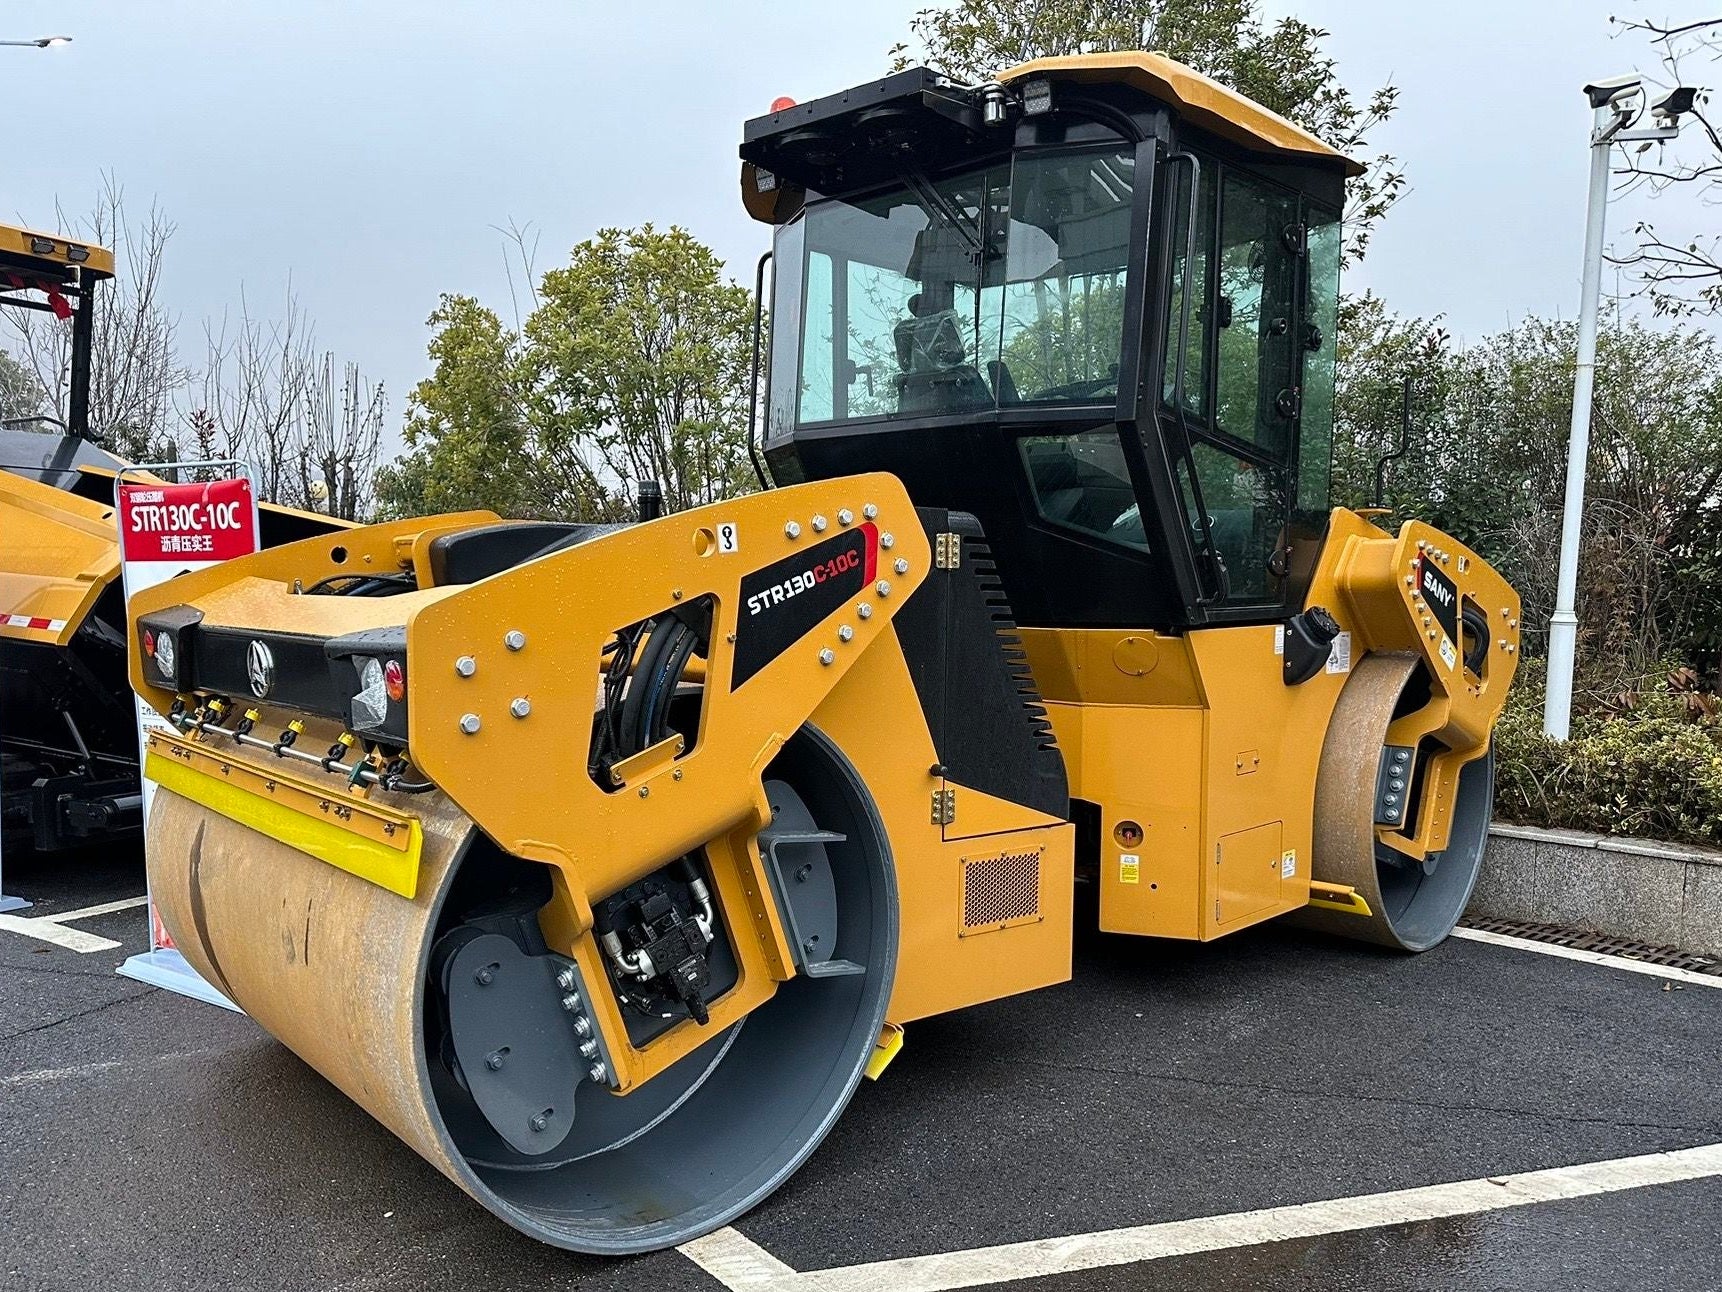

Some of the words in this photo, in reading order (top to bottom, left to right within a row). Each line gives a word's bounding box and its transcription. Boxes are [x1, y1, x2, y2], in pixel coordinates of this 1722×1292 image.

[131, 502, 241, 532] STR130C-10C
[161, 535, 213, 552] 沥青压实王
[747, 550, 859, 616] STR130C-10C
[1424, 571, 1453, 607] SANY
